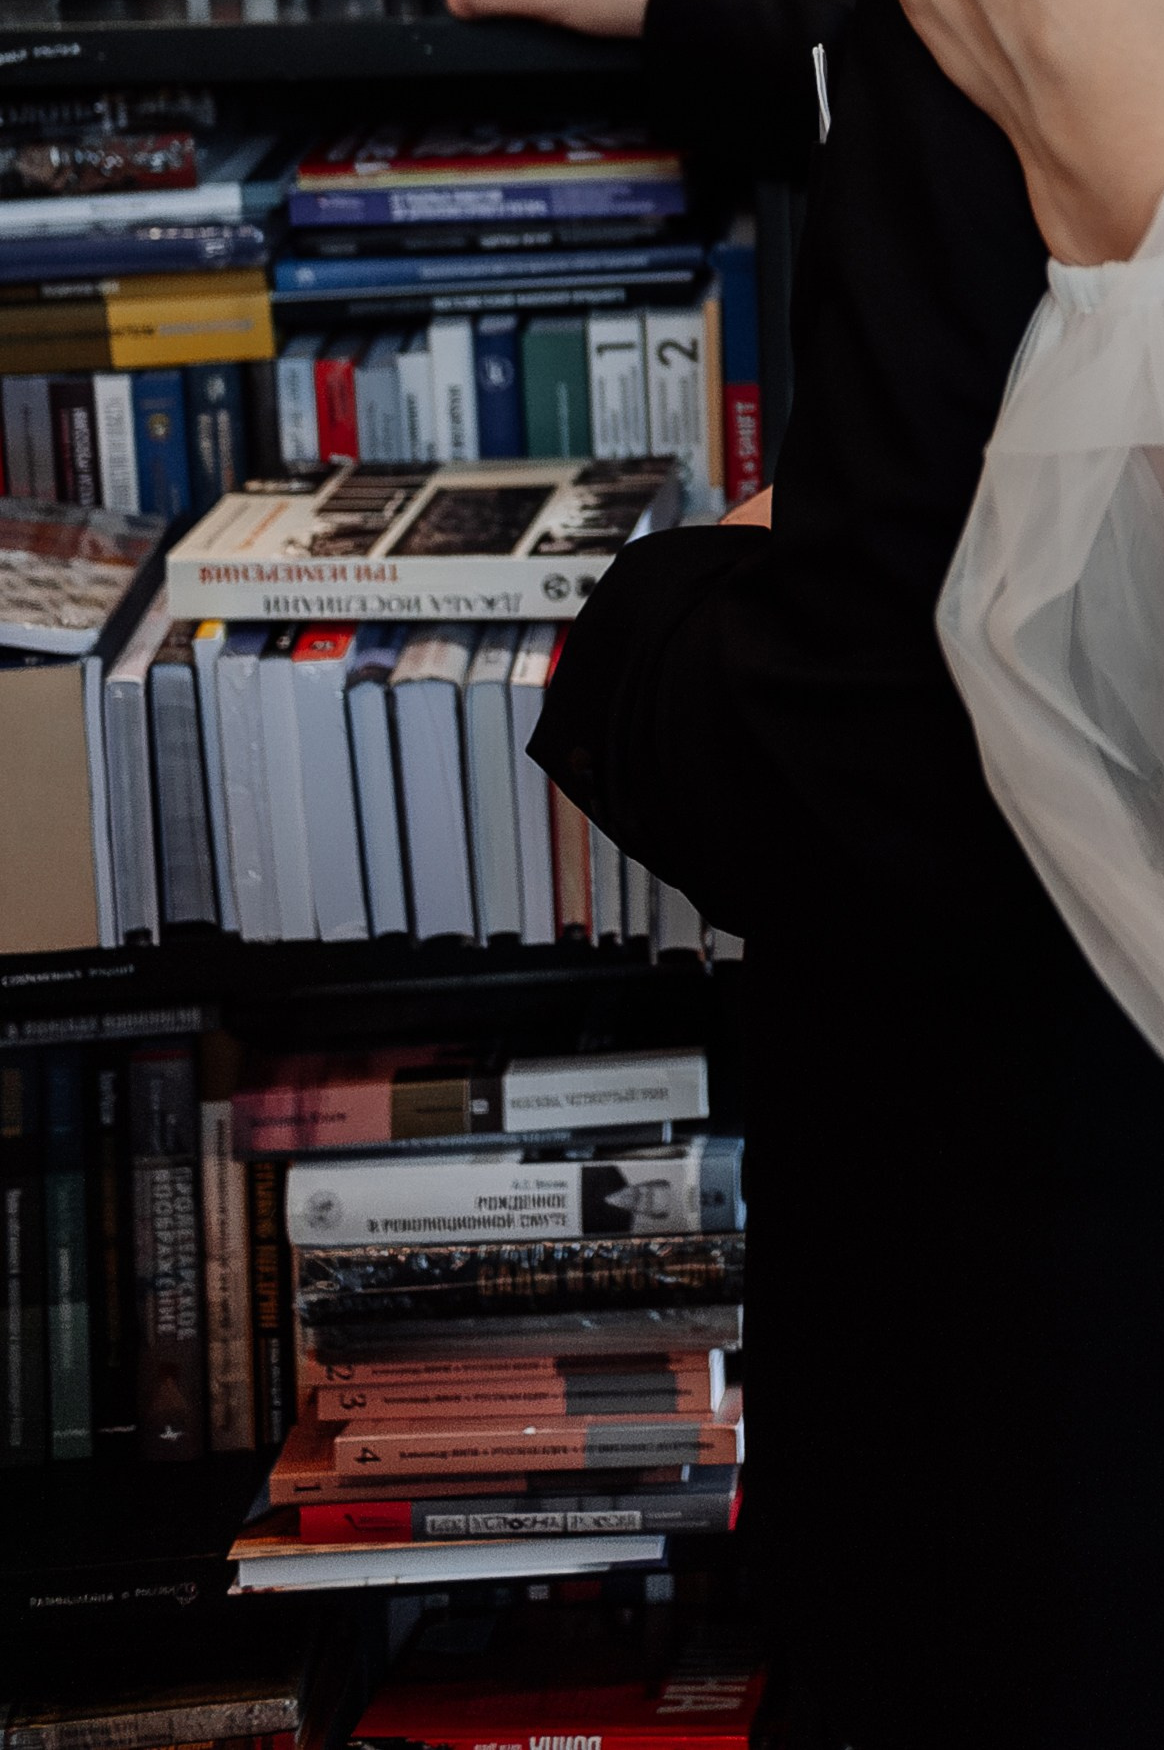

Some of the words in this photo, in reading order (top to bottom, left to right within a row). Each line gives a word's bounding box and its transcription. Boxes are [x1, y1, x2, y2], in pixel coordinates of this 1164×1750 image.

[596, 341, 637, 358] 1
[656, 337, 700, 369] 2
[340, 1393, 367, 1410] 3
[354, 1446, 381, 1465] 4
